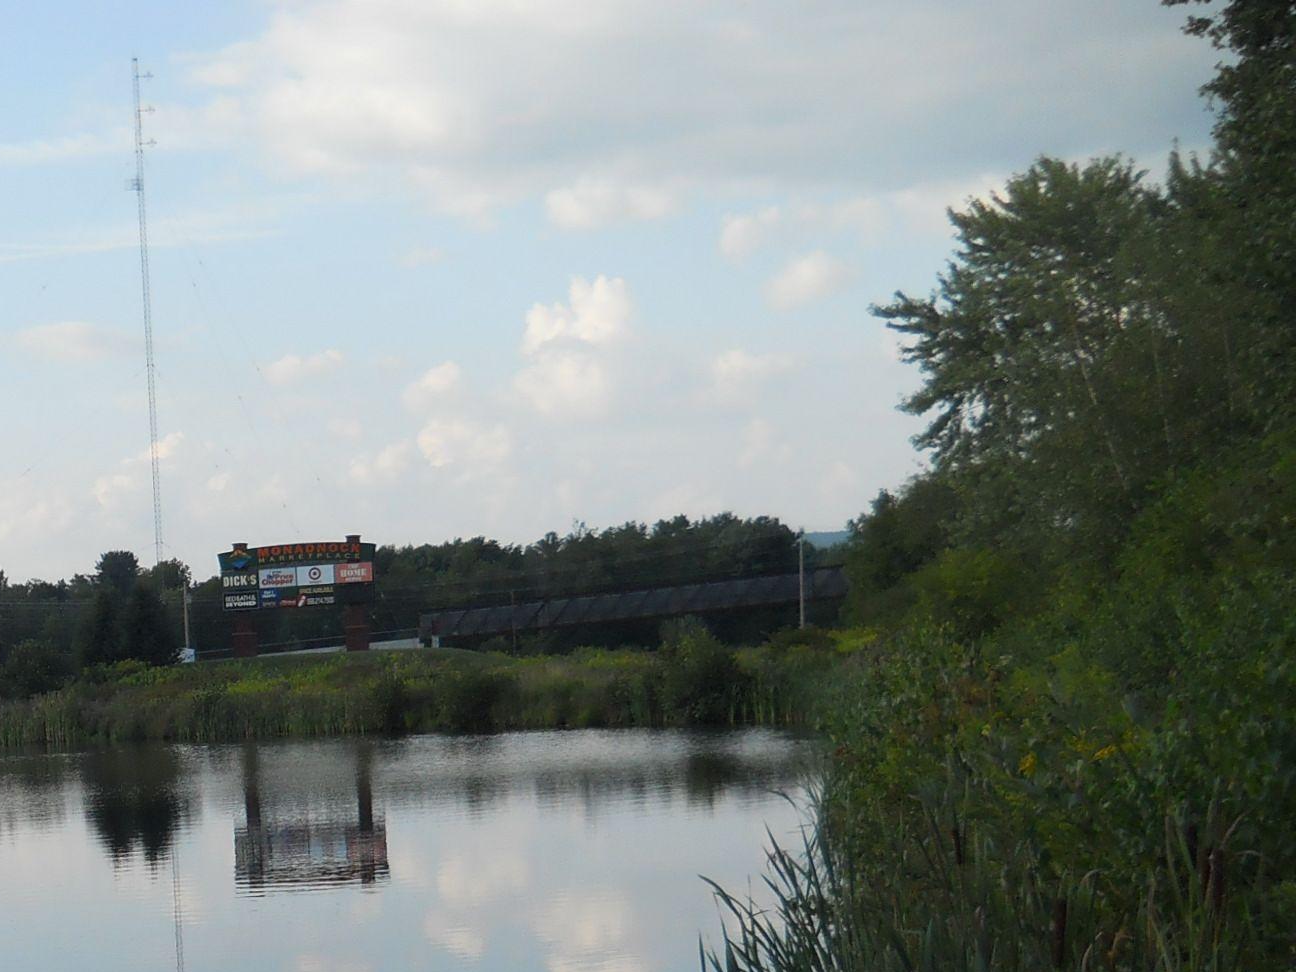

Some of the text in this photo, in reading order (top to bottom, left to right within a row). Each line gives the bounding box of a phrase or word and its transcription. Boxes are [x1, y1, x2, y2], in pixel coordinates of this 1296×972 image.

[257, 543, 361, 557] MONADNOCK
[258, 552, 360, 563] MARKETPLACE
[223, 574, 257, 587] DICK'S
